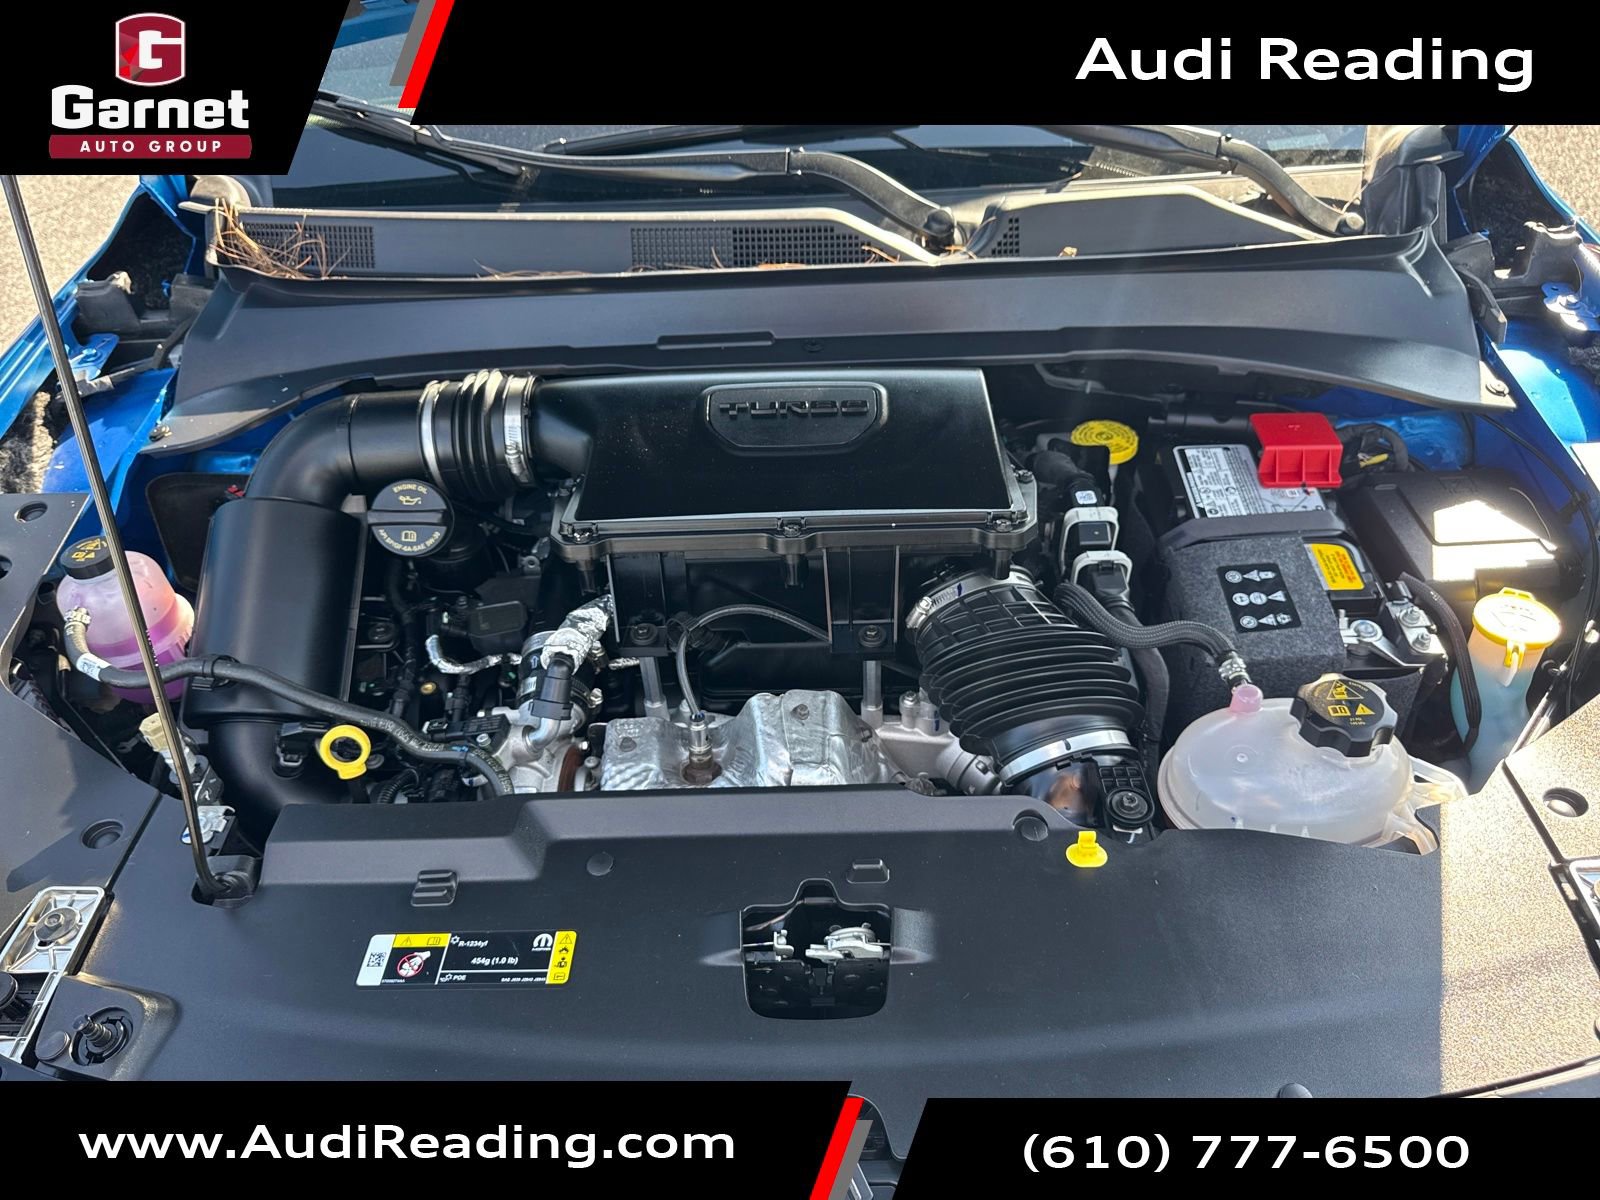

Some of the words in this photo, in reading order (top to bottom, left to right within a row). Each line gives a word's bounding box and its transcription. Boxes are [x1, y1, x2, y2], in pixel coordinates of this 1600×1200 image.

[719, 400, 870, 418] TURBO
[392, 484, 417, 493] ENGINE
[417, 485, 428, 494] OIL
[458, 940, 489, 949] R-1234yf
[470, 957, 491, 966] 454g
[491, 957, 507, 966] (1.0
[507, 957, 519, 966] lb)
